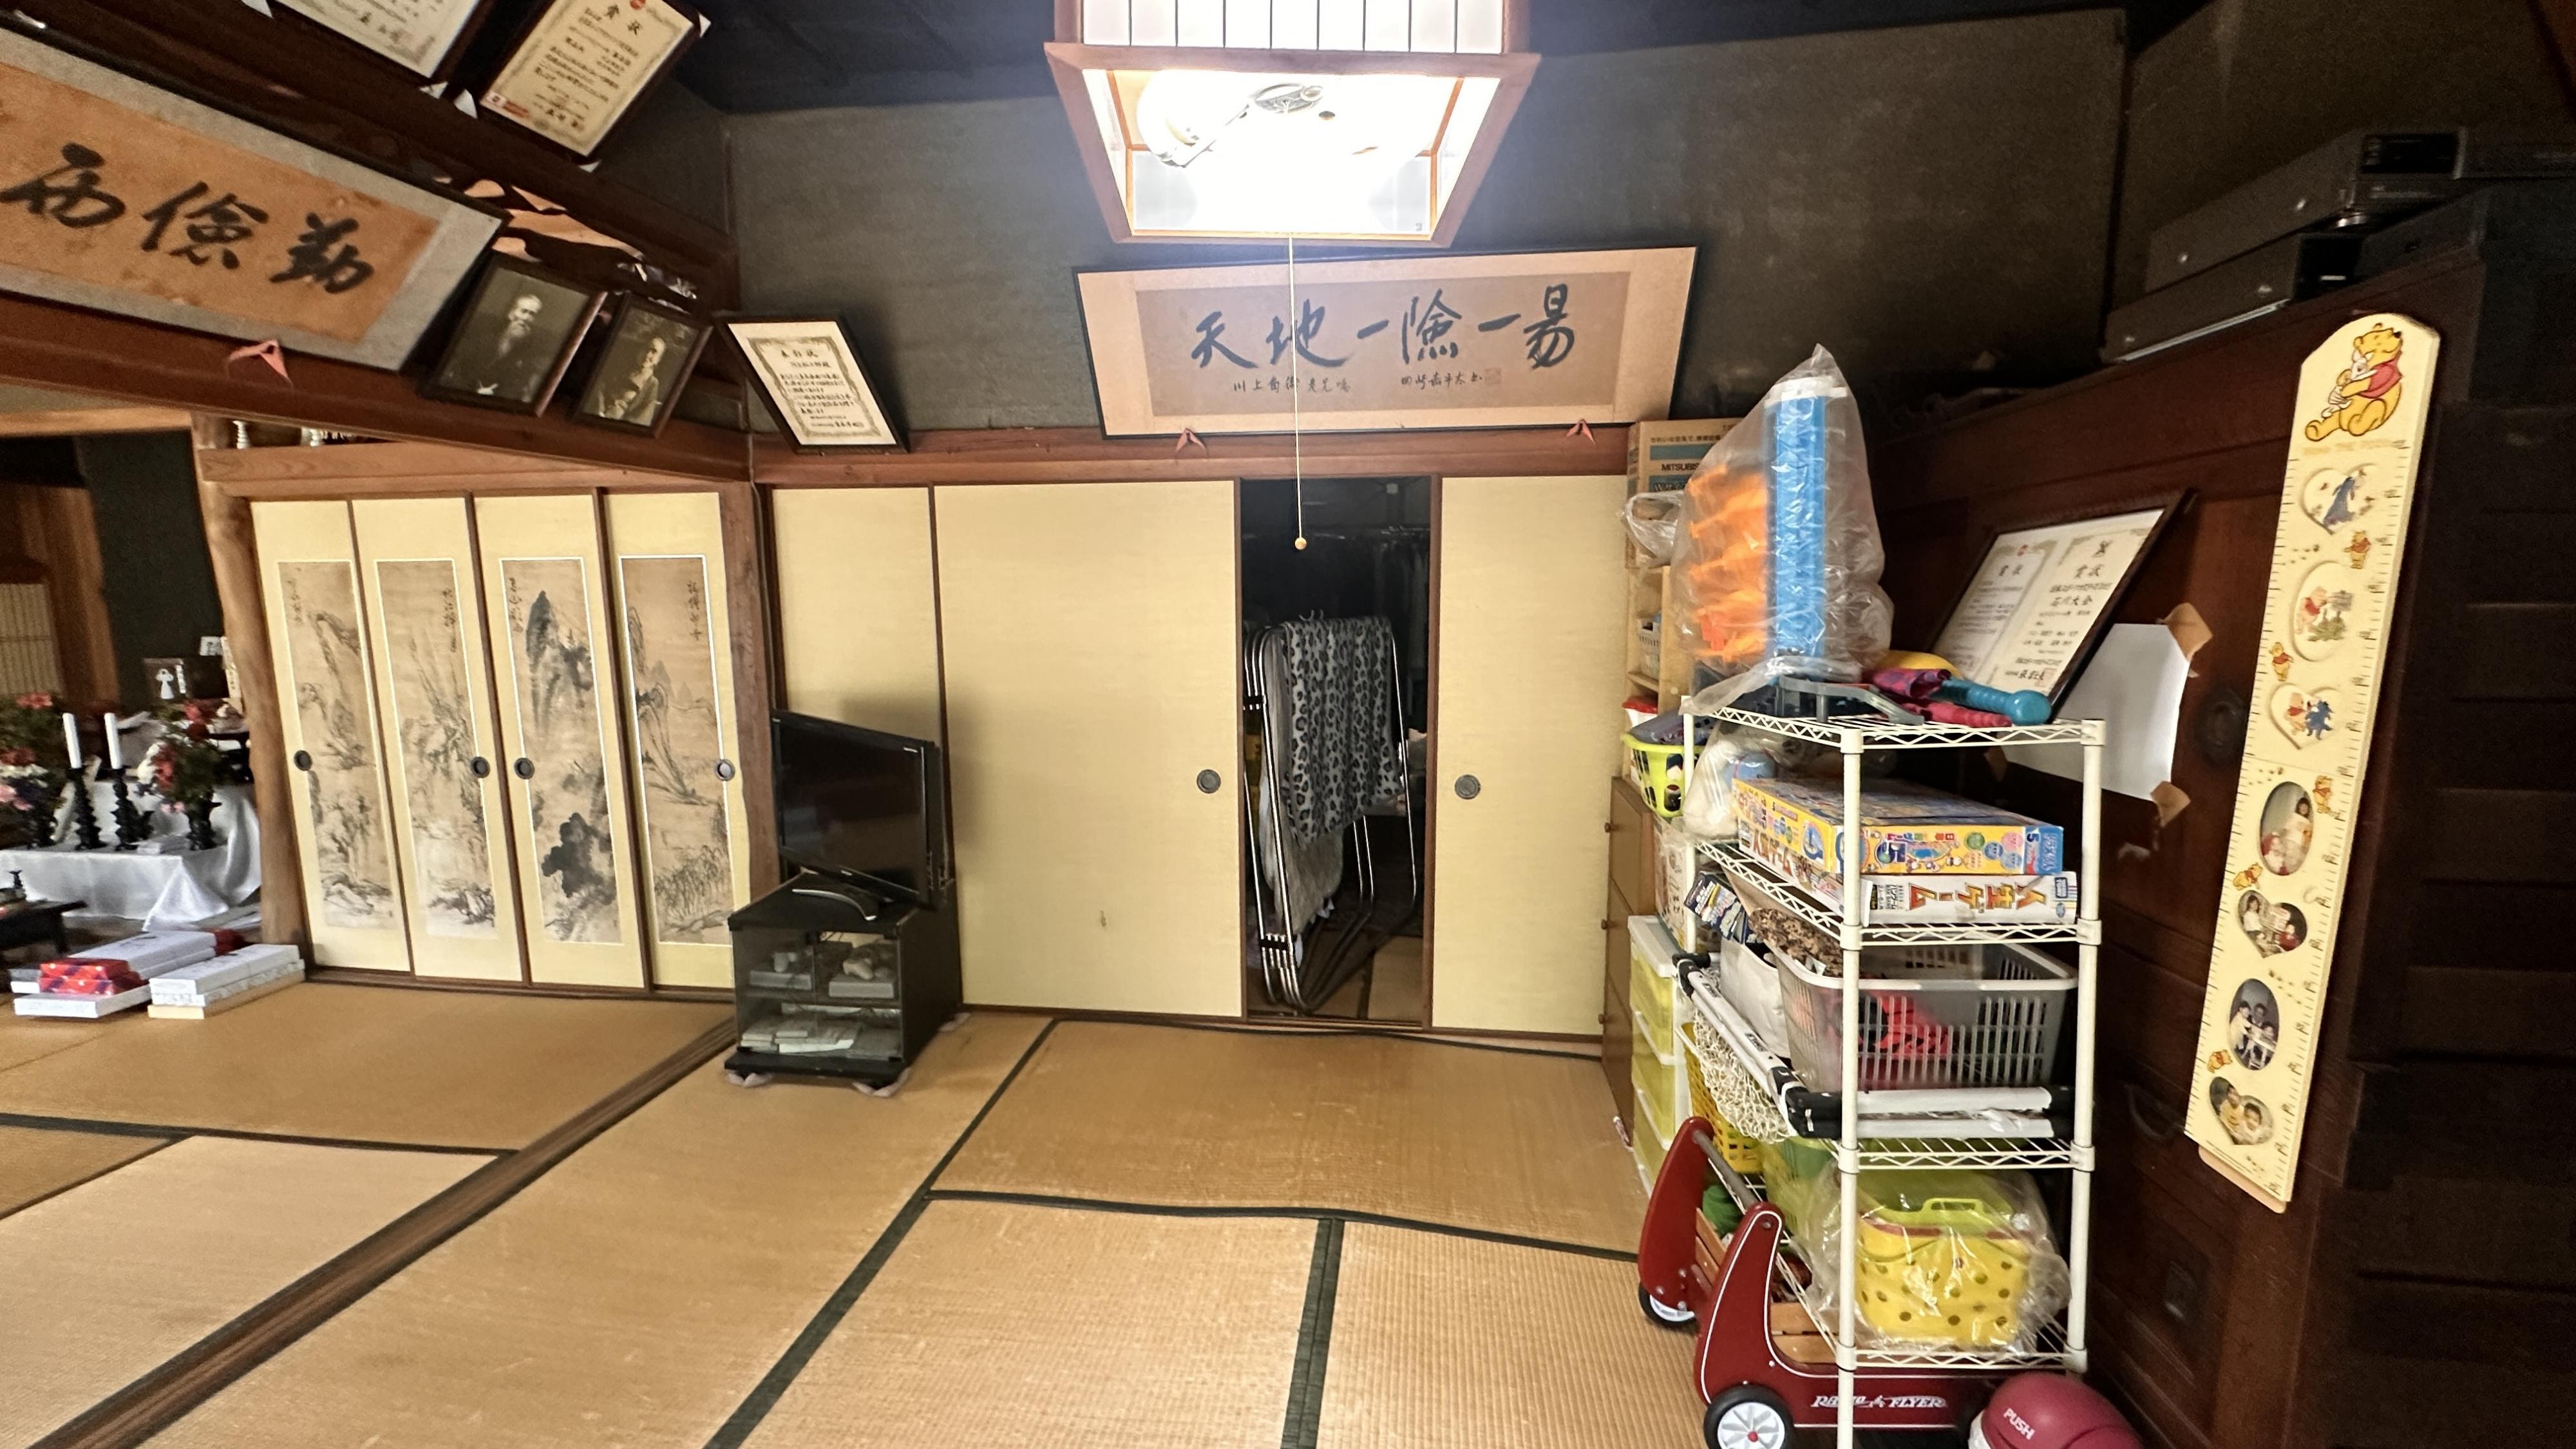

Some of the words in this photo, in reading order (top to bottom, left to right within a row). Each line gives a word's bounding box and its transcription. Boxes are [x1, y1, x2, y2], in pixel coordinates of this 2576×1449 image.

[1909, 882, 2047, 913] 人生ゲーム
[1888, 1396, 1946, 1408] FLYER
[2003, 1408, 2035, 1440] PUSH
